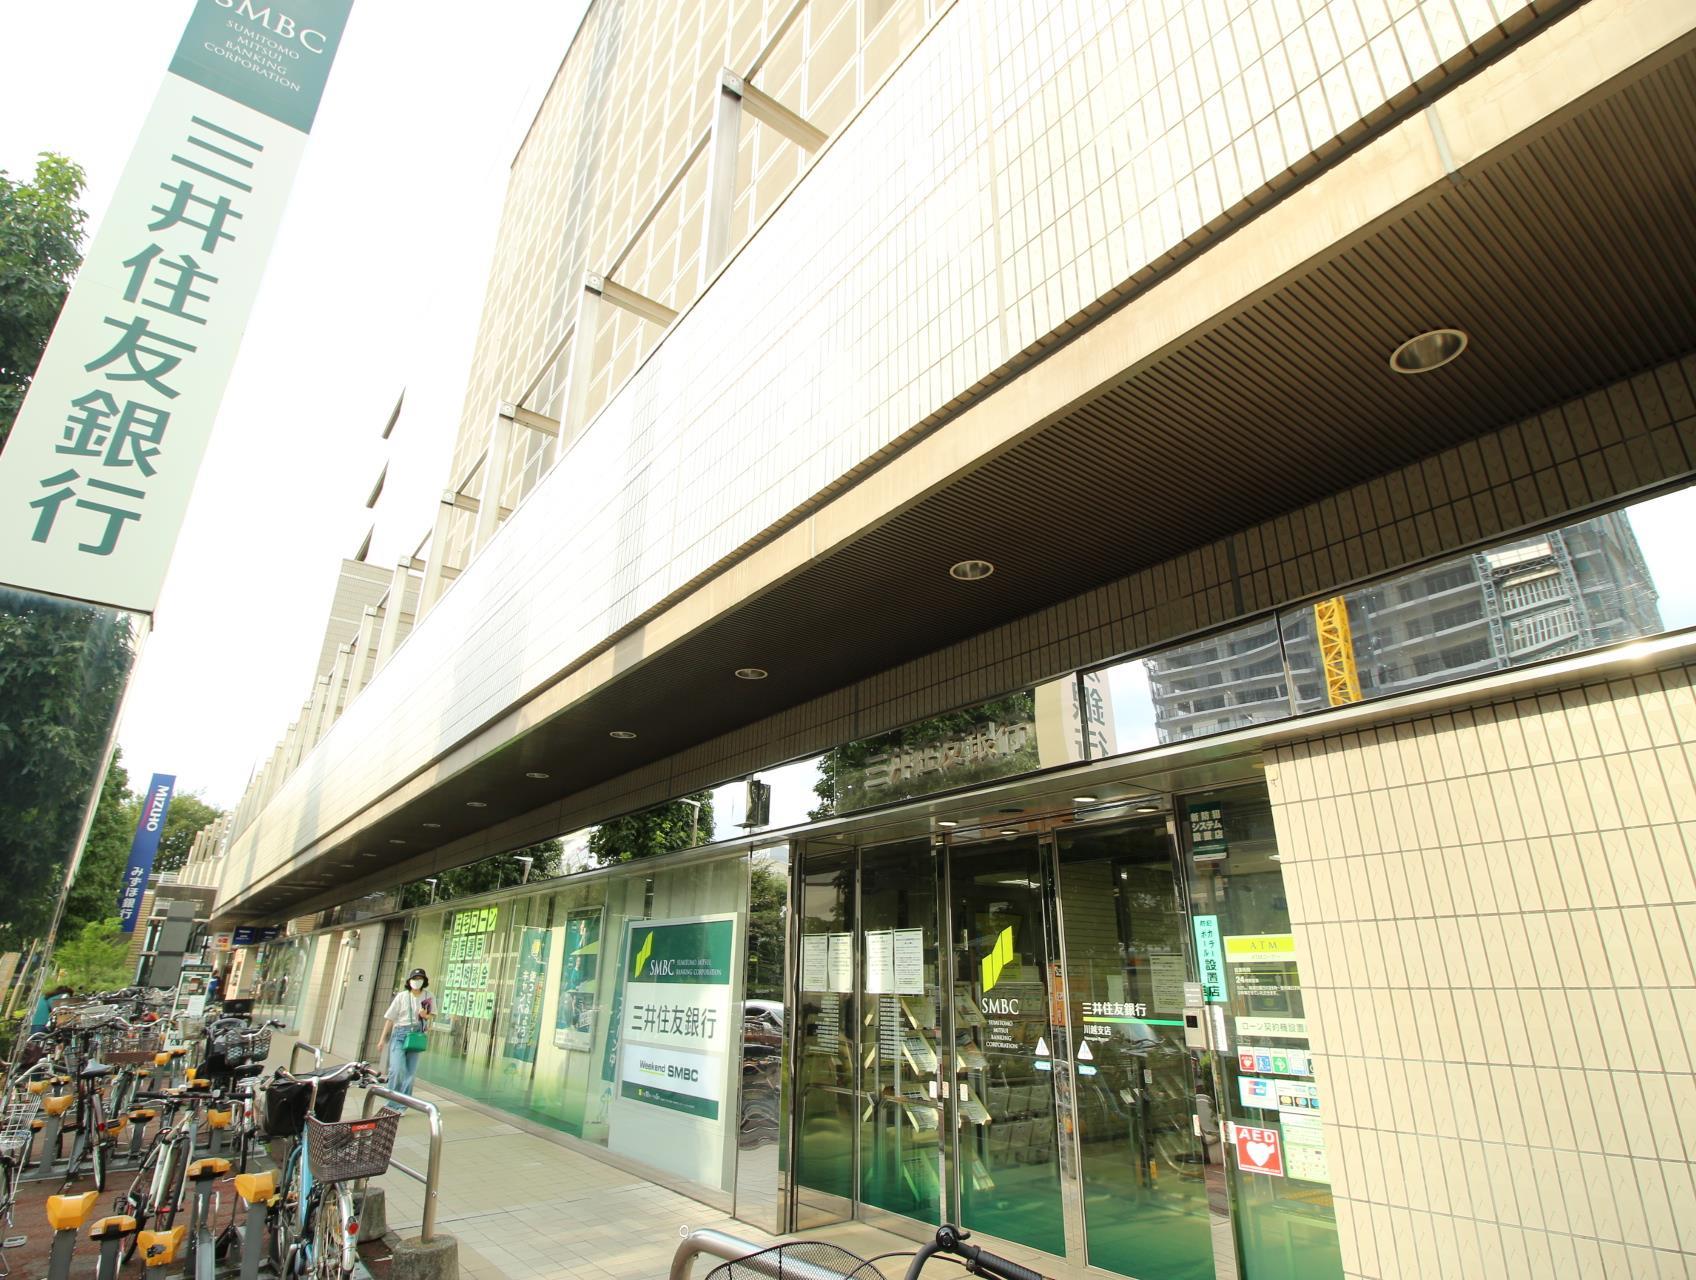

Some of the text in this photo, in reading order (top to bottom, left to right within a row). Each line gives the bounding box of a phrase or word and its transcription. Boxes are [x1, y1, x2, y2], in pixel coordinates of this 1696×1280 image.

[226, 19, 300, 60] SUMITOMO
[237, 36, 282, 62] MITSUI
[204, 41, 300, 92] CORPORATION
[225, 40, 287, 75] BANKING
[29, 115, 264, 556] 三井住友銀行
[146, 785, 170, 832] MIZUHO
[1192, 820, 1222, 832] システム
[120, 866, 144, 920] みずほ銀行
[1250, 940, 1278, 950] ATM
[649, 959, 675, 976] SMBC
[982, 997, 1020, 1015] SMBC
[1082, 1002, 1147, 1017] 三井住友銀行
[631, 1004, 717, 1040] 三井住友銀行
[1083, 1024, 1112, 1036] 川越支店
[1241, 1022, 1308, 1033] ローン契約機設置
[986, 1041, 1019, 1049] CORPORATION
[639, 1060, 699, 1082] Weekend SMBC
[1238, 1128, 1275, 1143] AED
